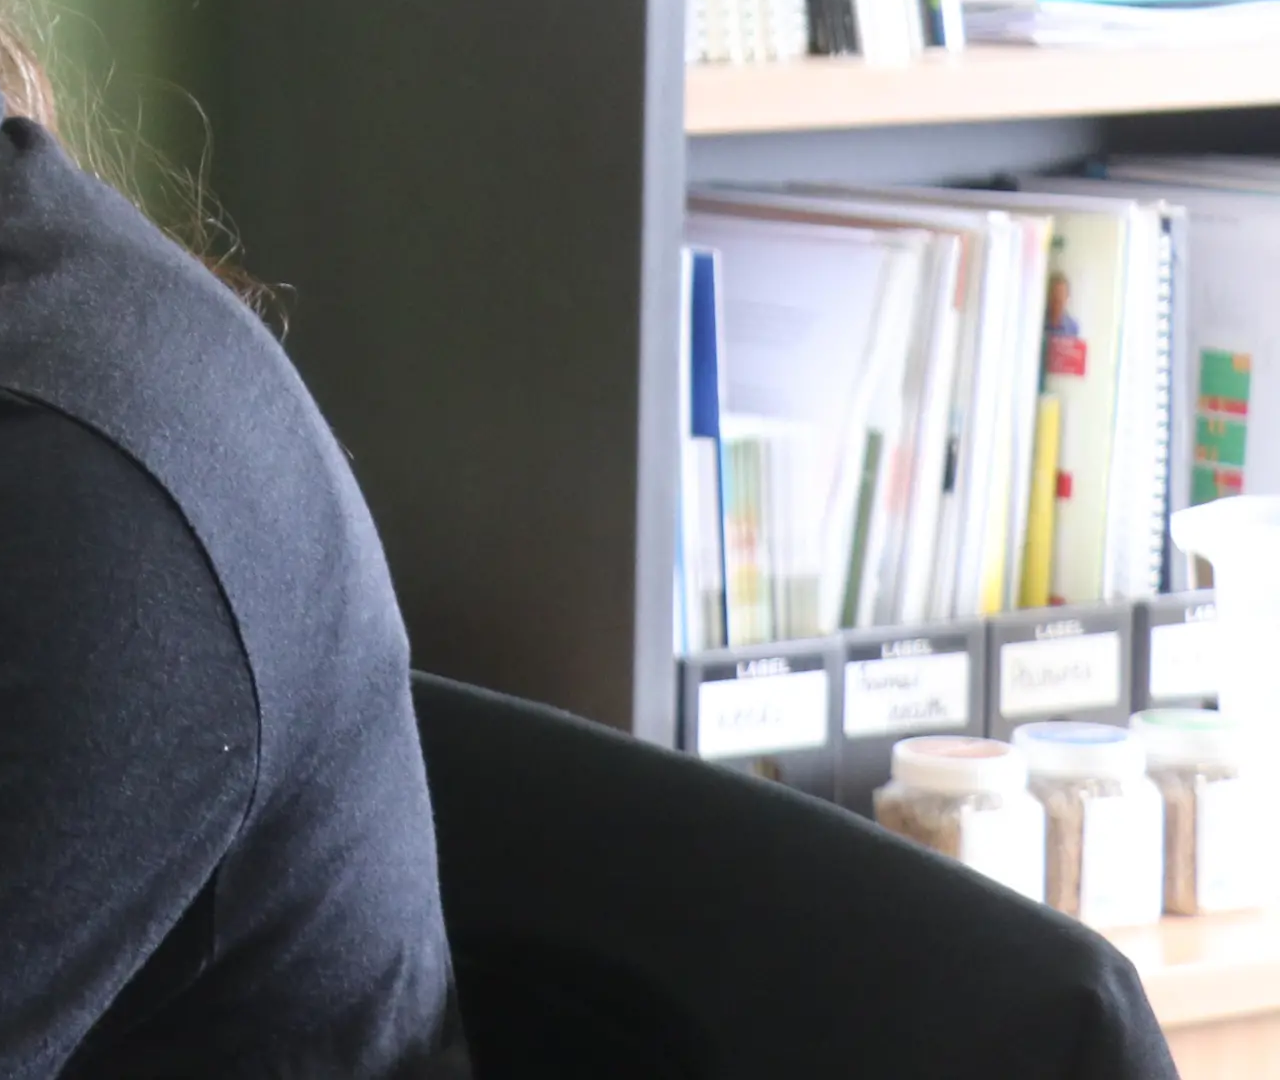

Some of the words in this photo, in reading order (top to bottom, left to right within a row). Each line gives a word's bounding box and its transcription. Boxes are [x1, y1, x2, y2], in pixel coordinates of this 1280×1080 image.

[1035, 620, 1085, 641] LABEL
[880, 638, 933, 659] LABEL
[736, 657, 791, 679] LABEL
